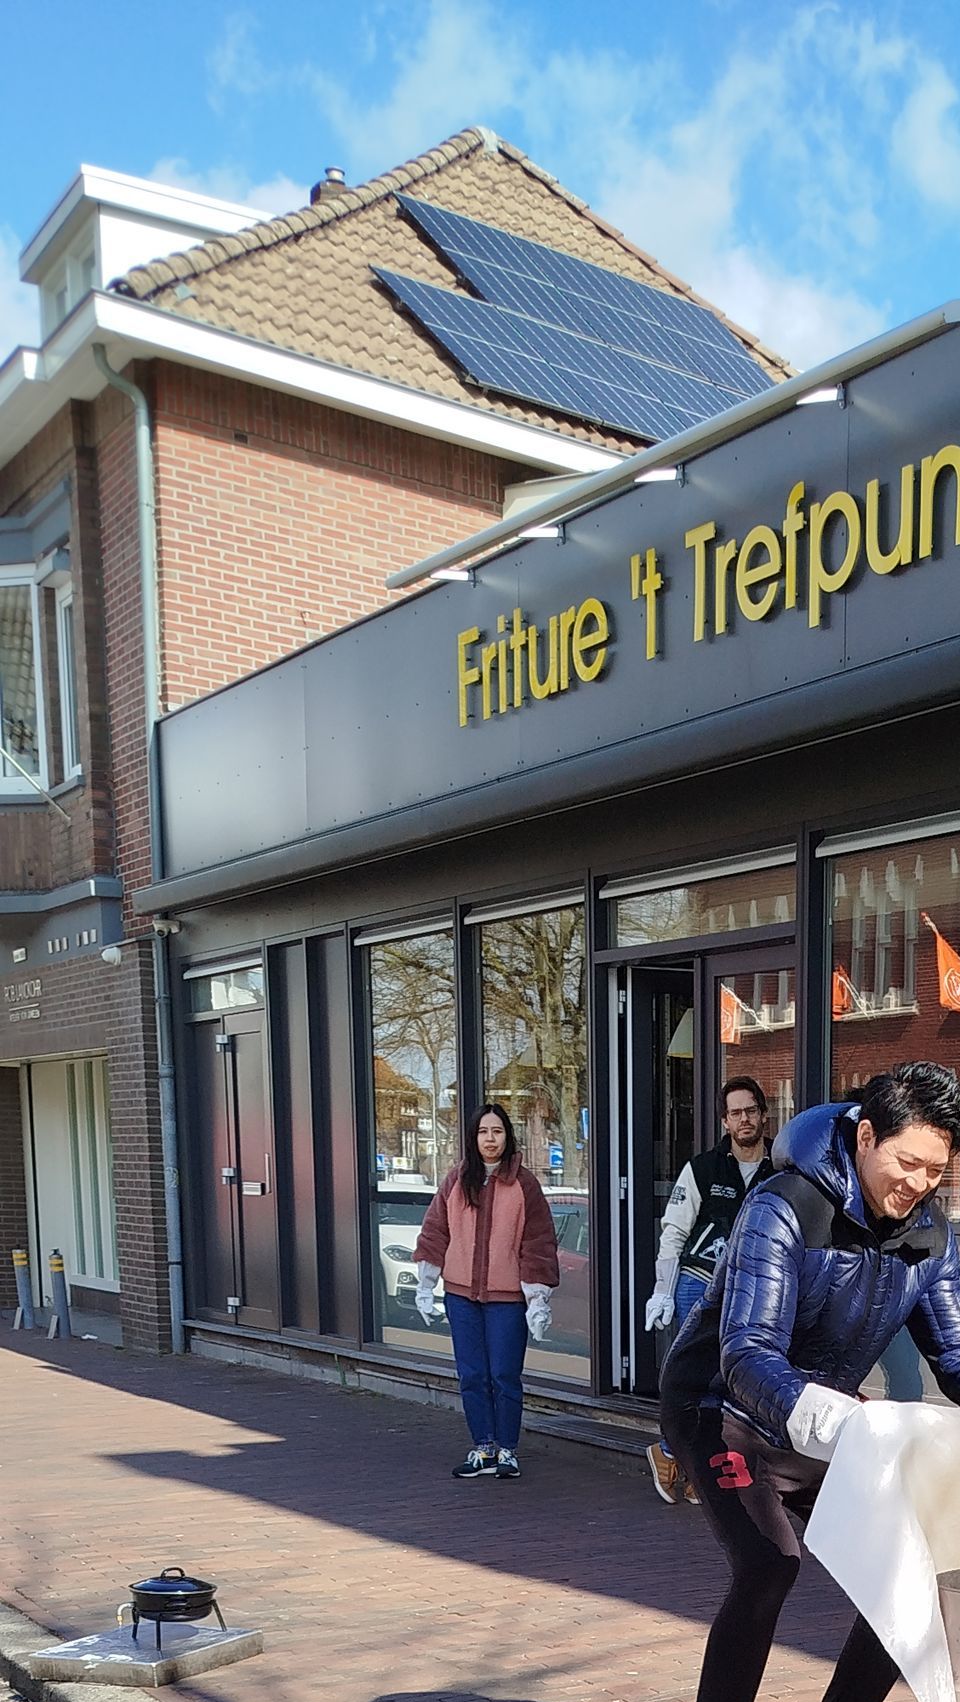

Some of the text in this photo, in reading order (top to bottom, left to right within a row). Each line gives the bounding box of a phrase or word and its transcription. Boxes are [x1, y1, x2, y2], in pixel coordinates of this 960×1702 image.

[457, 597, 609, 727] Friture
[630, 547, 662, 660] 't
[709, 1451, 753, 1488] 3
